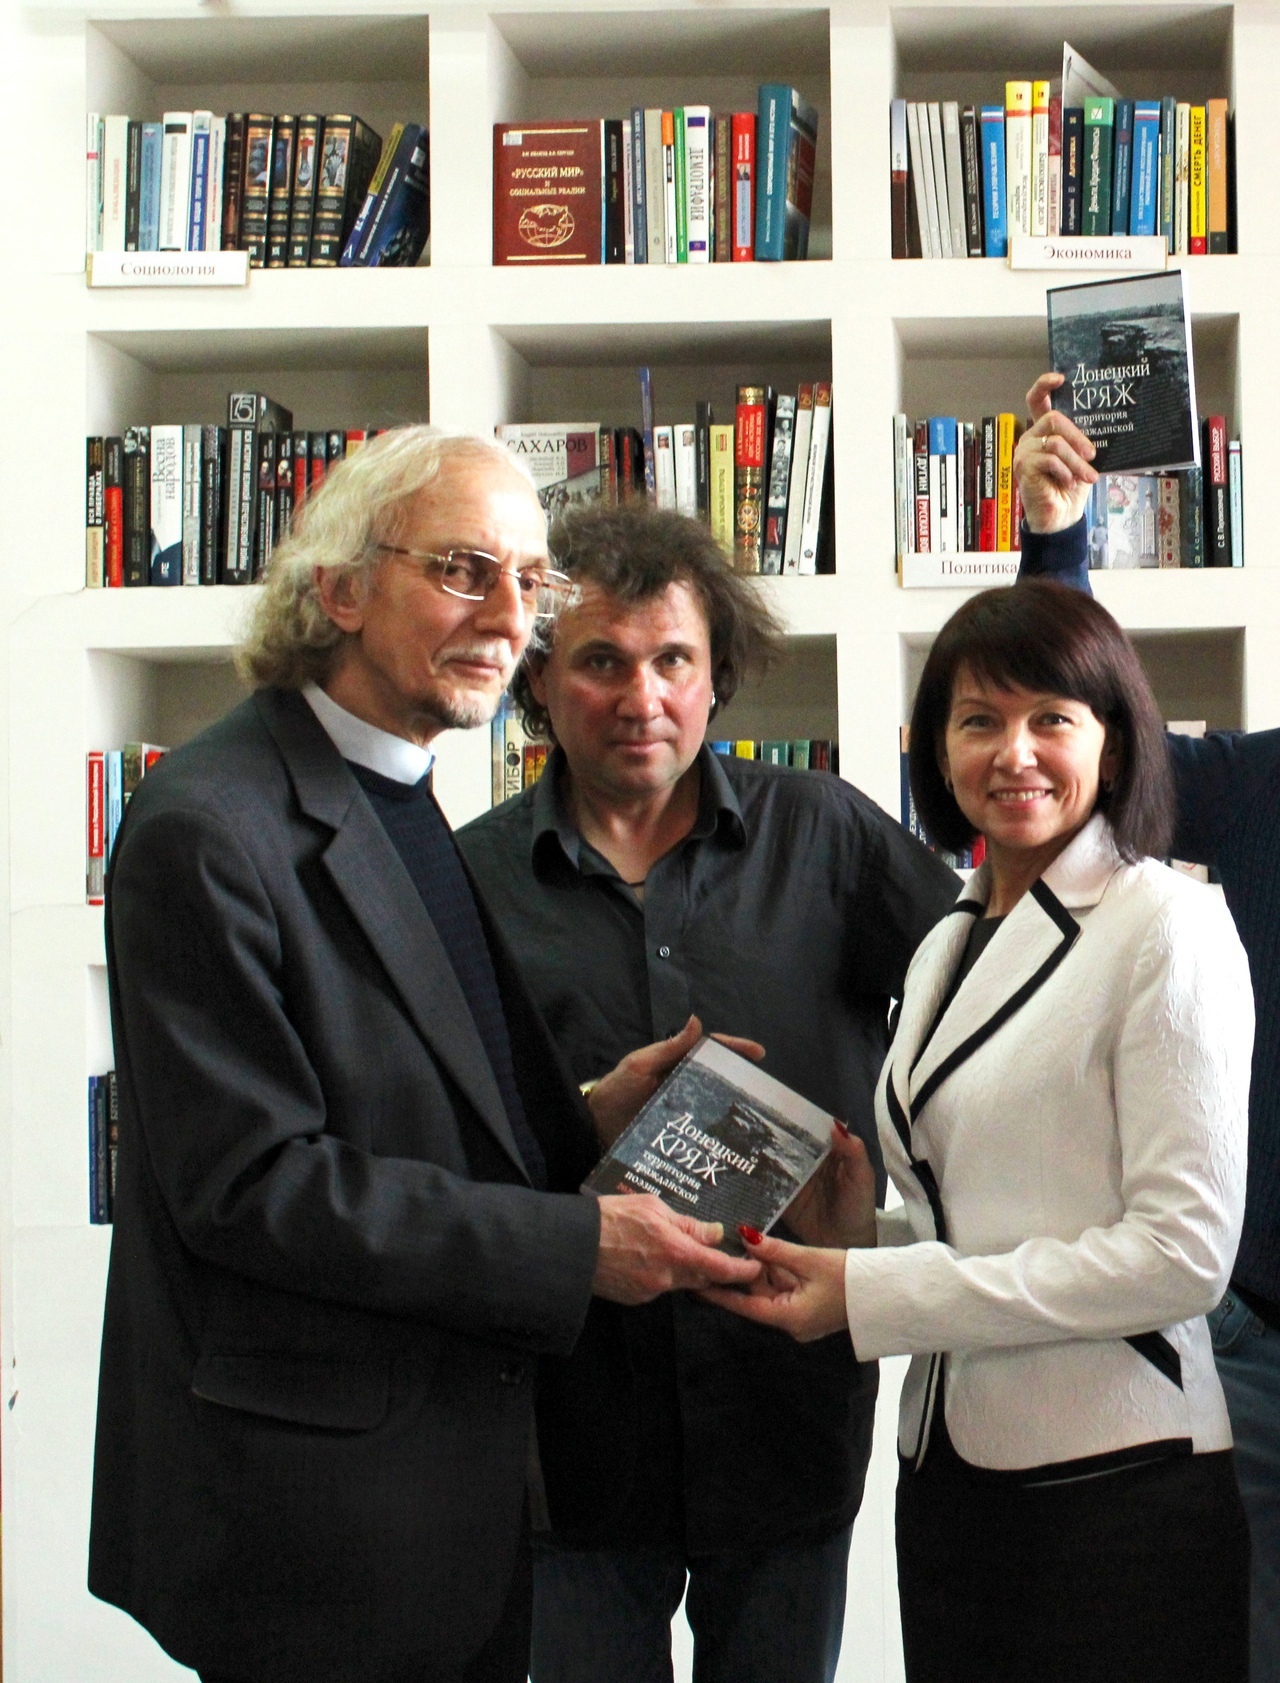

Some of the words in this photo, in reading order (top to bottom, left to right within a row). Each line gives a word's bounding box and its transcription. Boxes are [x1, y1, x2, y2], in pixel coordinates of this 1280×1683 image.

[1193, 114, 1203, 146] ДЕНЕГ
[1193, 149, 1203, 187] СМЕРТЬ
[689, 148, 705, 222] ДЕМОГРАФИЯ
[1043, 245, 1132, 259] Экономика
[120, 262, 215, 276] Социология
[1072, 357, 1150, 388] Донецкий
[1073, 382, 1136, 411] КРЯЖ
[1073, 411, 1128, 426] территория
[1211, 428, 1220, 452] ВЫБОР
[152, 438, 165, 483] Весна
[164, 436, 181, 499] народов
[917, 456, 928, 491] ДУГИН
[1212, 452, 1222, 482] РУССКИЙ
[1000, 466, 1011, 490] Удар
[1001, 493, 1009, 504] по
[918, 501, 929, 535] РУССКАЯ
[1002, 508, 1010, 543] России
[941, 561, 1018, 575] Политика
[650, 1128, 728, 1187] КРЯЖ
[667, 1112, 759, 1176] Донецкий
[624, 1171, 662, 1198] поэзии
[632, 1161, 699, 1204] гражданской
[643, 1150, 701, 1191] территория
